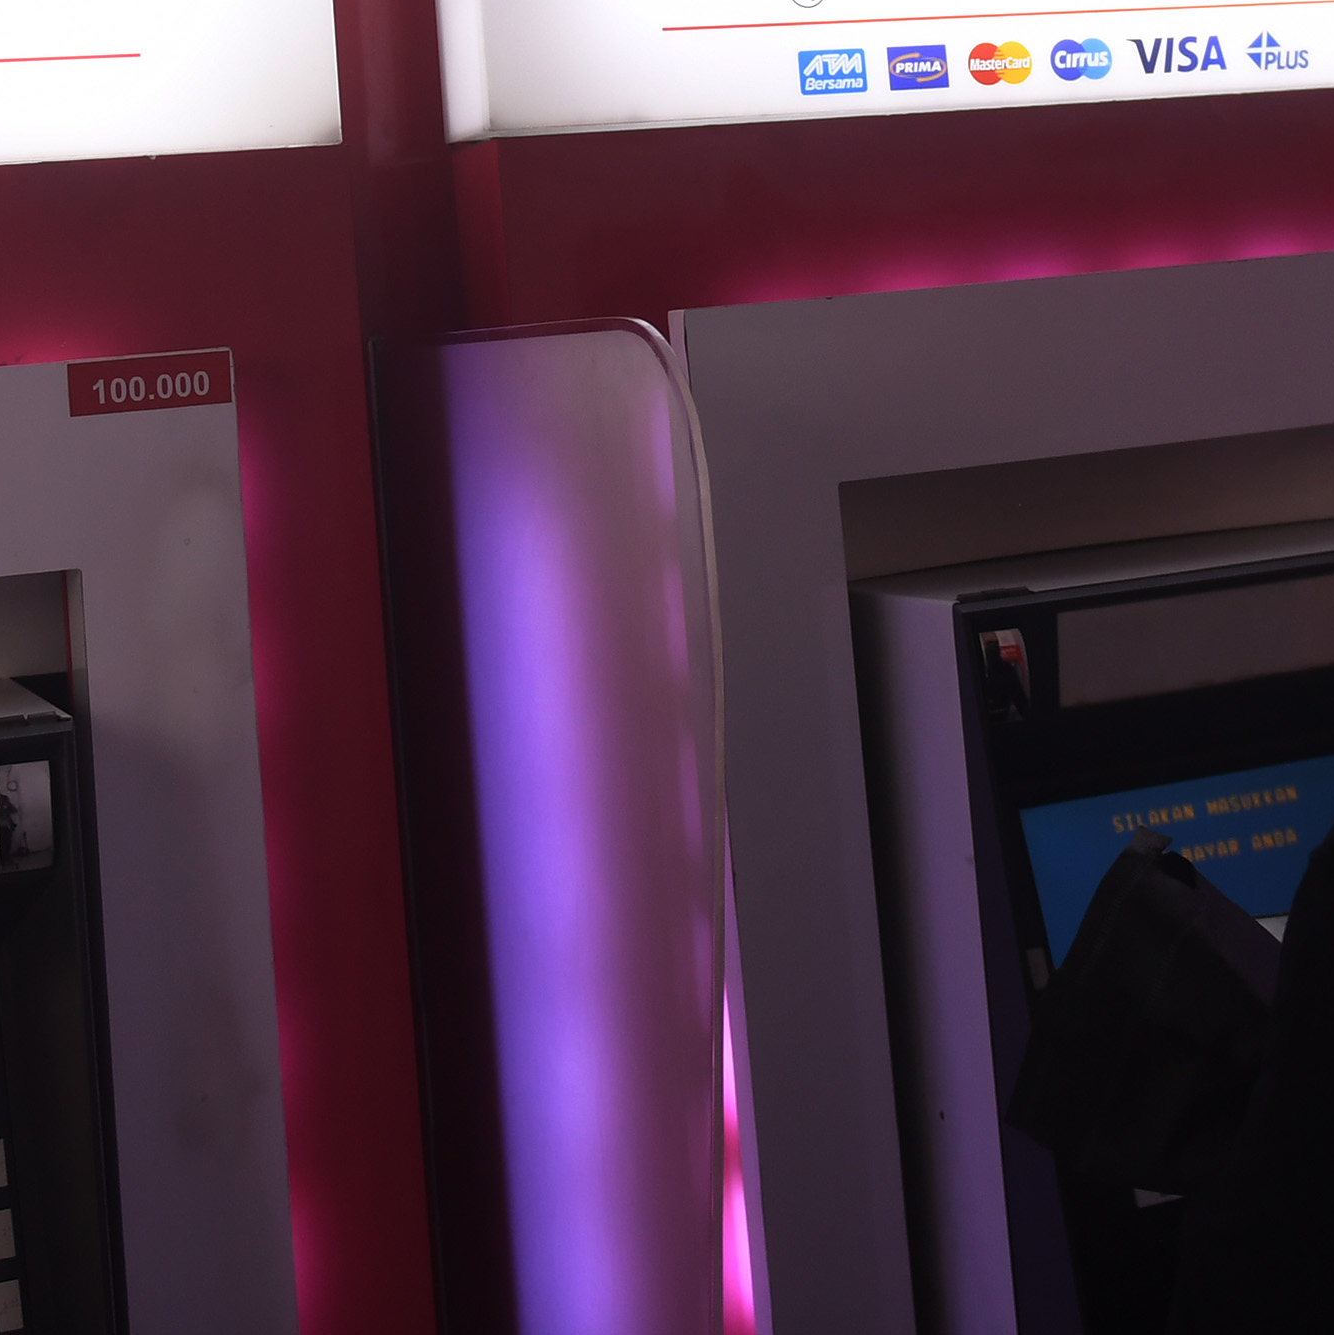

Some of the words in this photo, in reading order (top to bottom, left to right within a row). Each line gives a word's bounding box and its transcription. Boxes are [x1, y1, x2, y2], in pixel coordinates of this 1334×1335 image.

[803, 52, 863, 77] ATM
[969, 56, 1032, 72] MasterCard
[1054, 50, 1109, 69] Cirrus
[1126, 35, 1227, 75] VISA
[1264, 49, 1310, 71] PLUS
[895, 60, 942, 75] PRIMA
[805, 76, 864, 92] Bersama
[92, 370, 210, 405] 100.000
[1112, 803, 1196, 834] SILAKAN
[1205, 785, 1299, 817] MASUKKAN
[1251, 827, 1299, 852] ANDA
